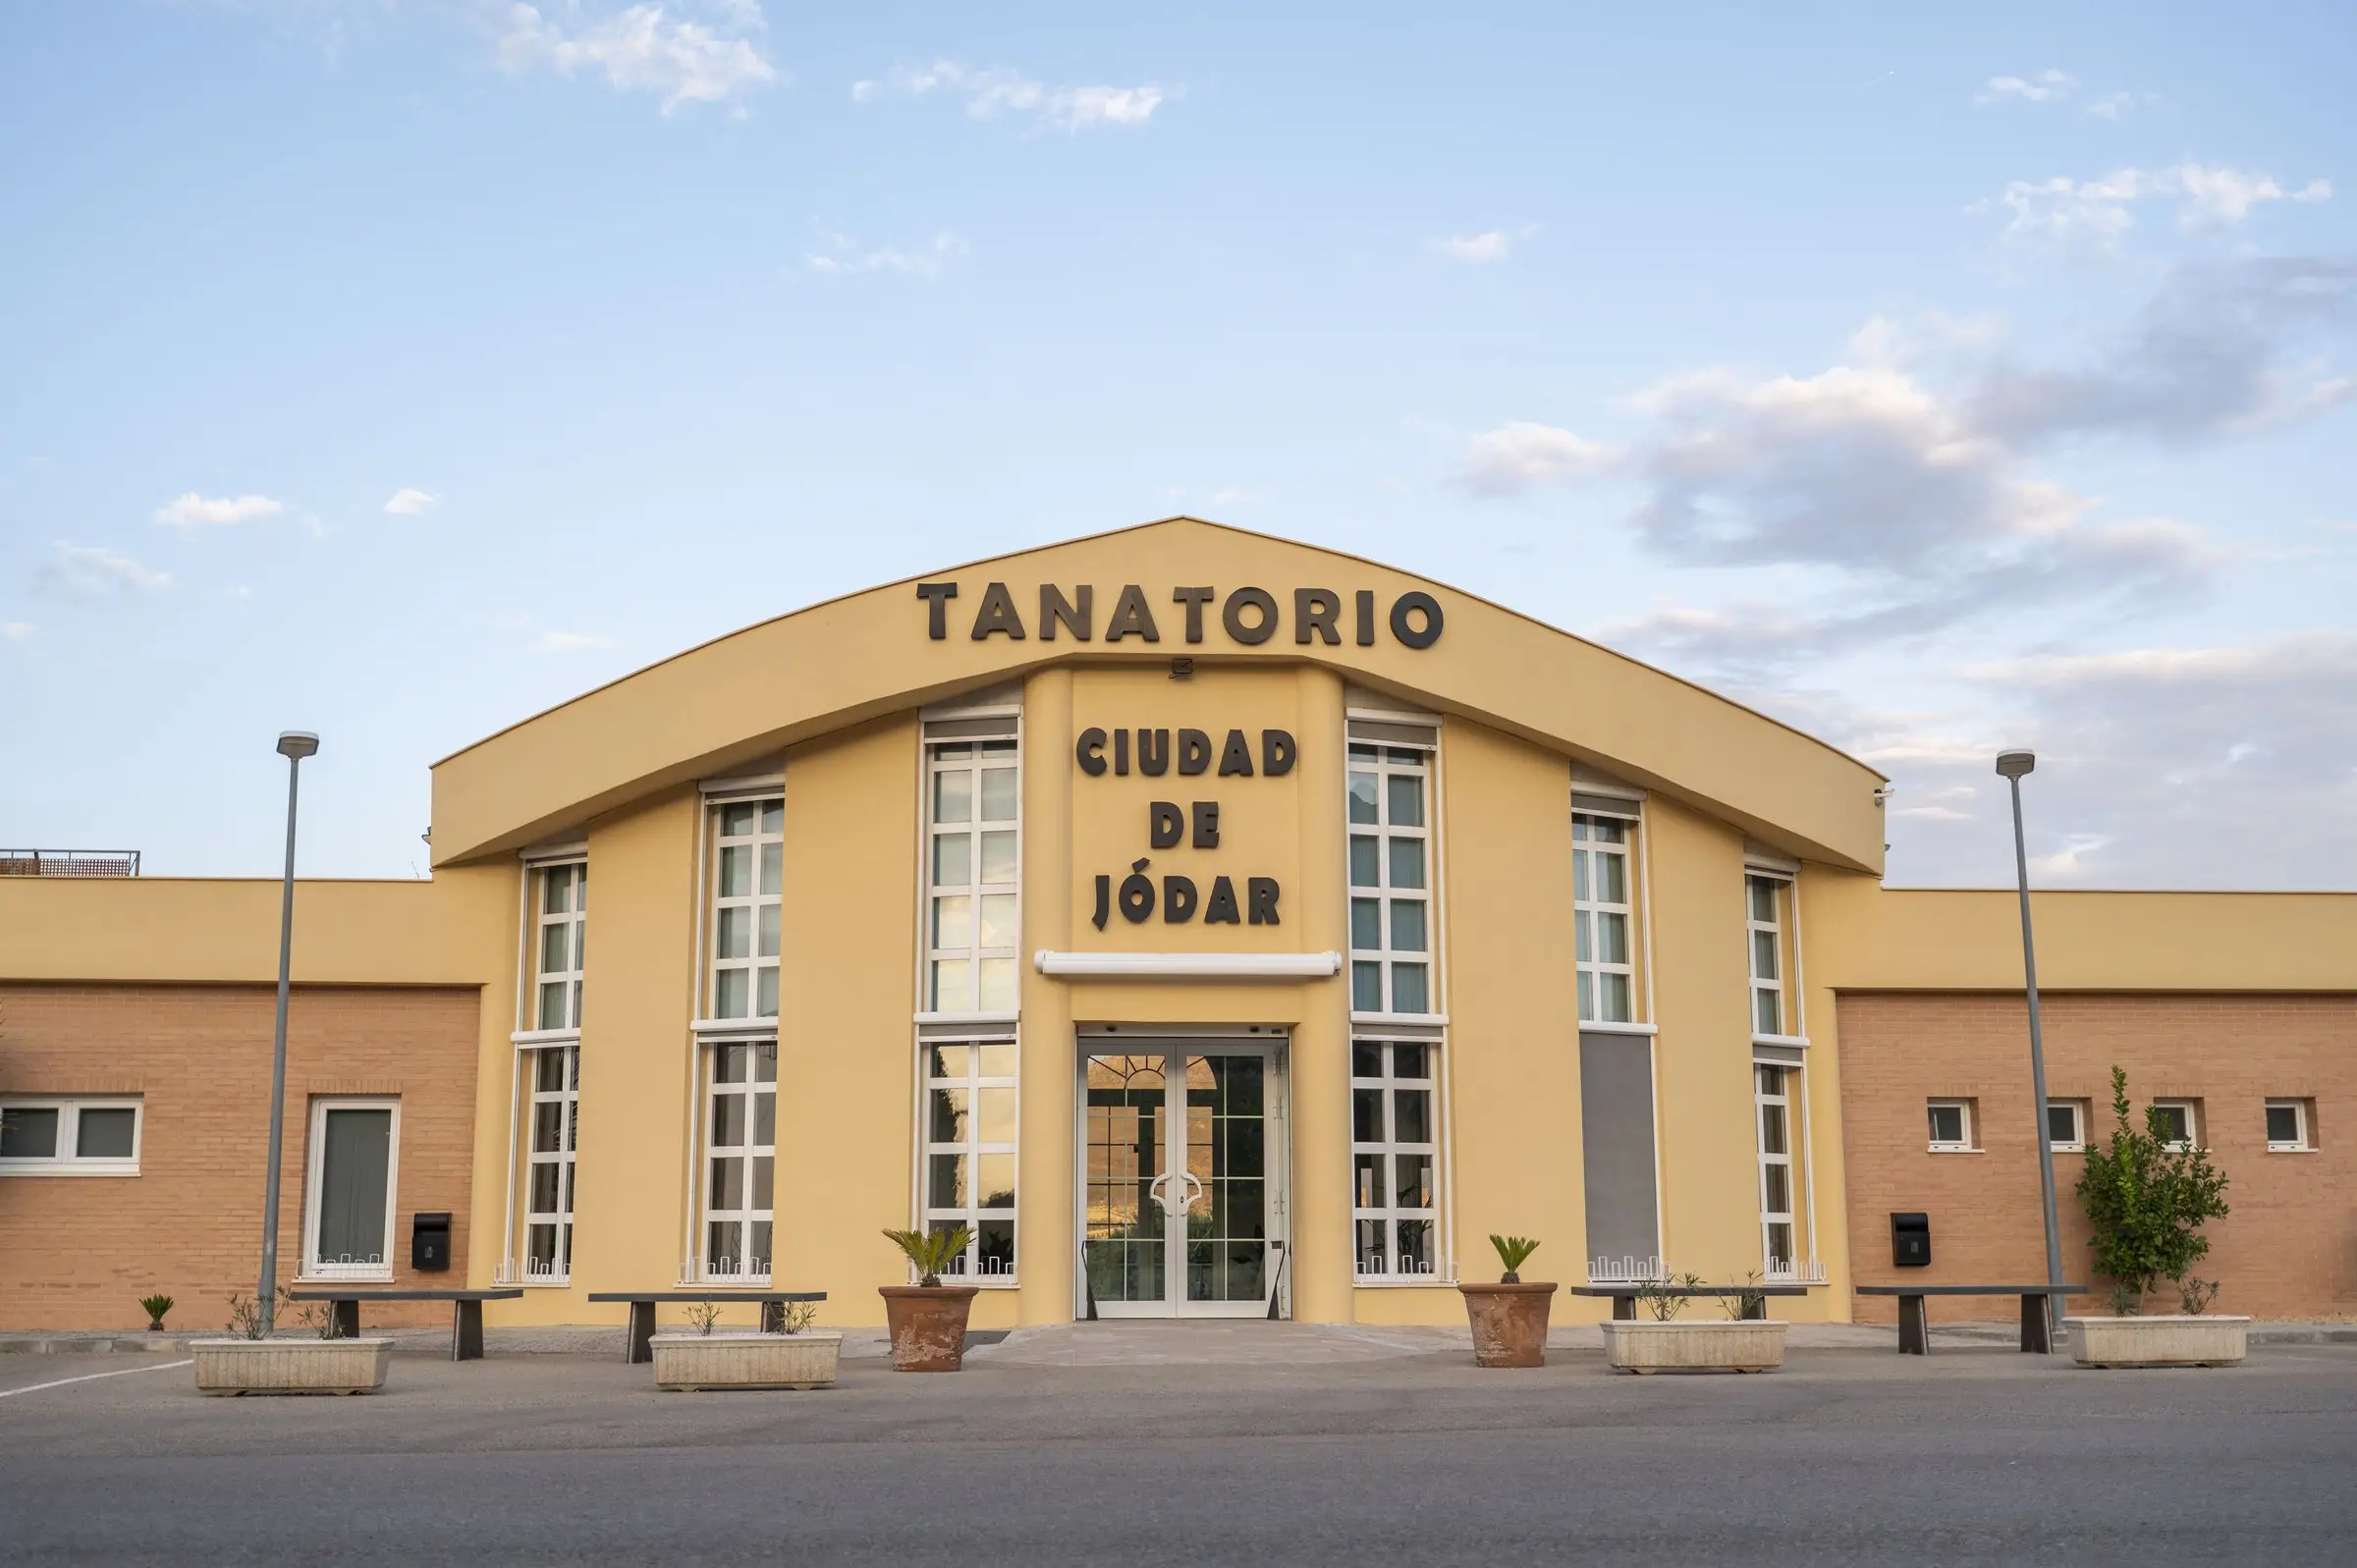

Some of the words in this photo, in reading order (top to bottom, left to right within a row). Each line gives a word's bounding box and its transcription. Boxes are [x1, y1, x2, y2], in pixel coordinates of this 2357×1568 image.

[915, 581, 1445, 650] TANATORIO
[1075, 728, 1297, 777] CIUDAD
[1150, 801, 1221, 849] DE
[1091, 857, 1281, 932] JÓDAR
